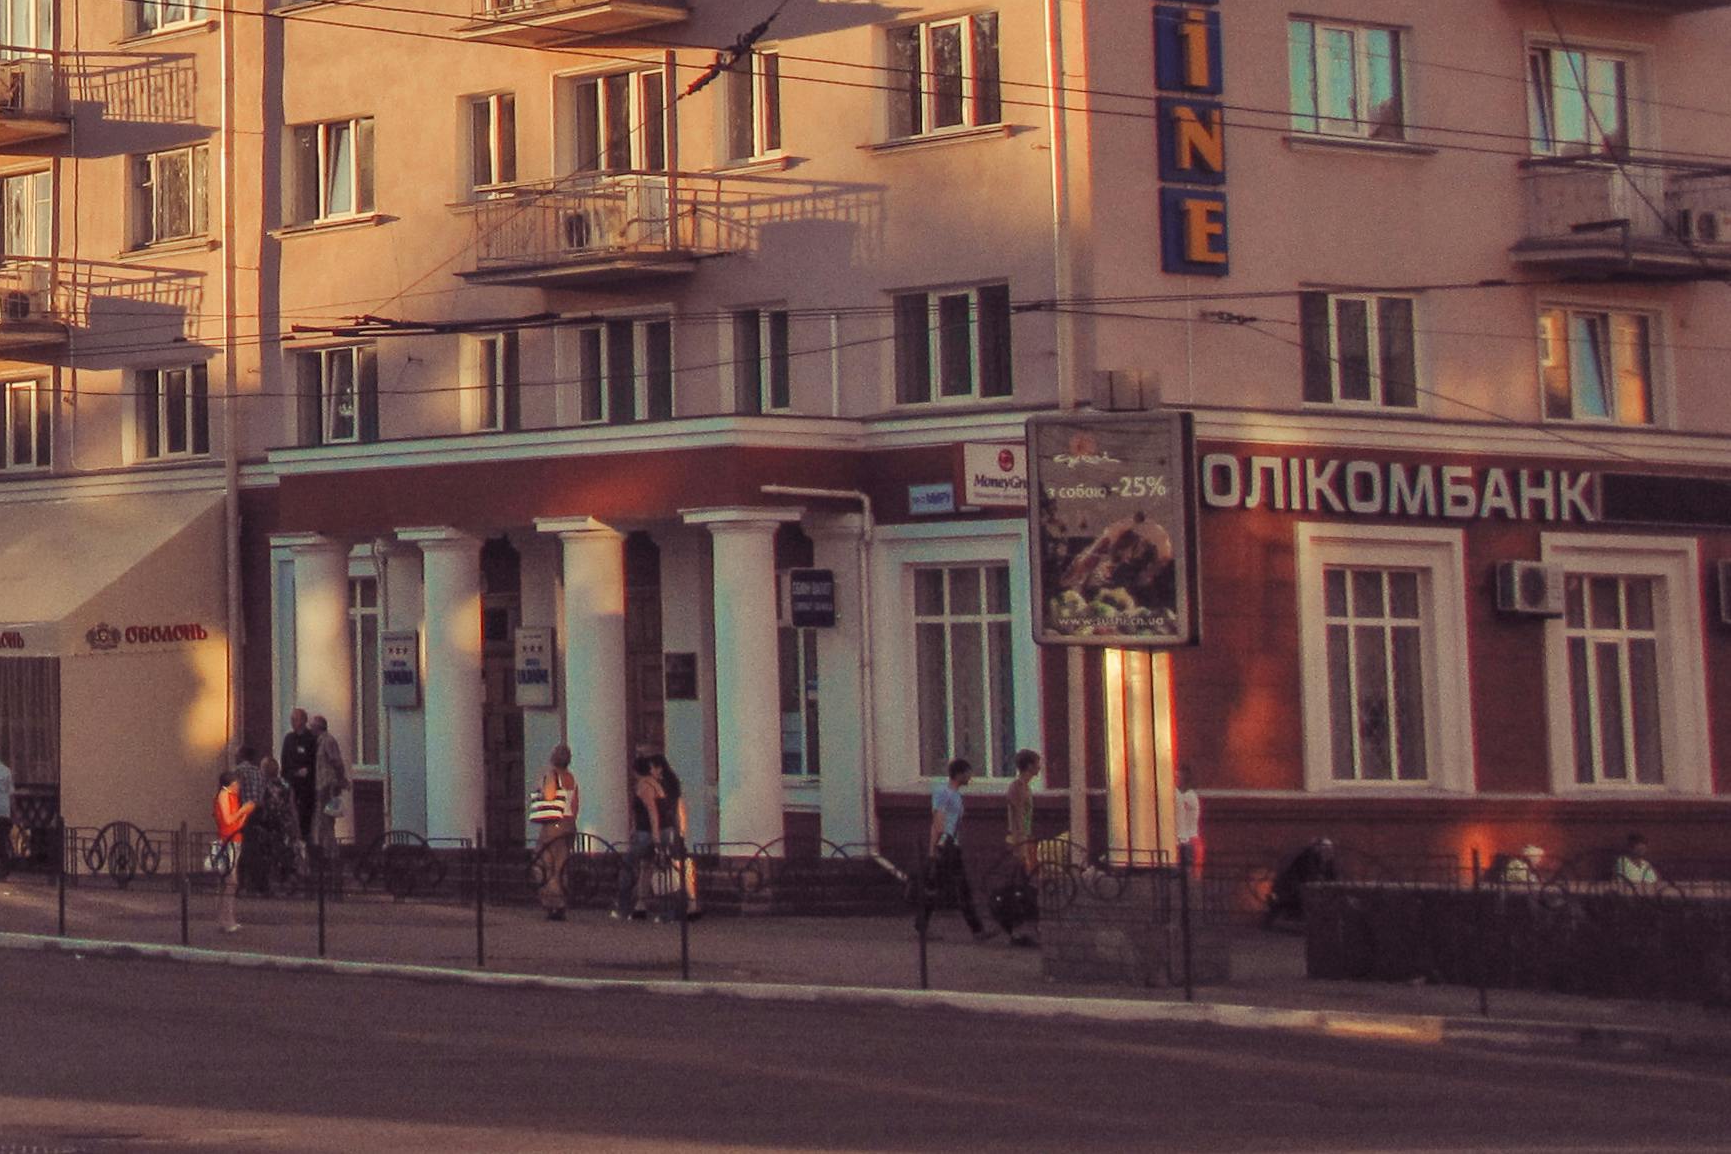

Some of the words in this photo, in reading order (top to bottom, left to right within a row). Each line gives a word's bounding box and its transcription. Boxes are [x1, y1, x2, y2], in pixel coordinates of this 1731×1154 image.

[1059, 484, 1107, 498] собою
[1111, 475, 1166, 497] -25%
[125, 624, 208, 644] ОБОЛОНЬ
